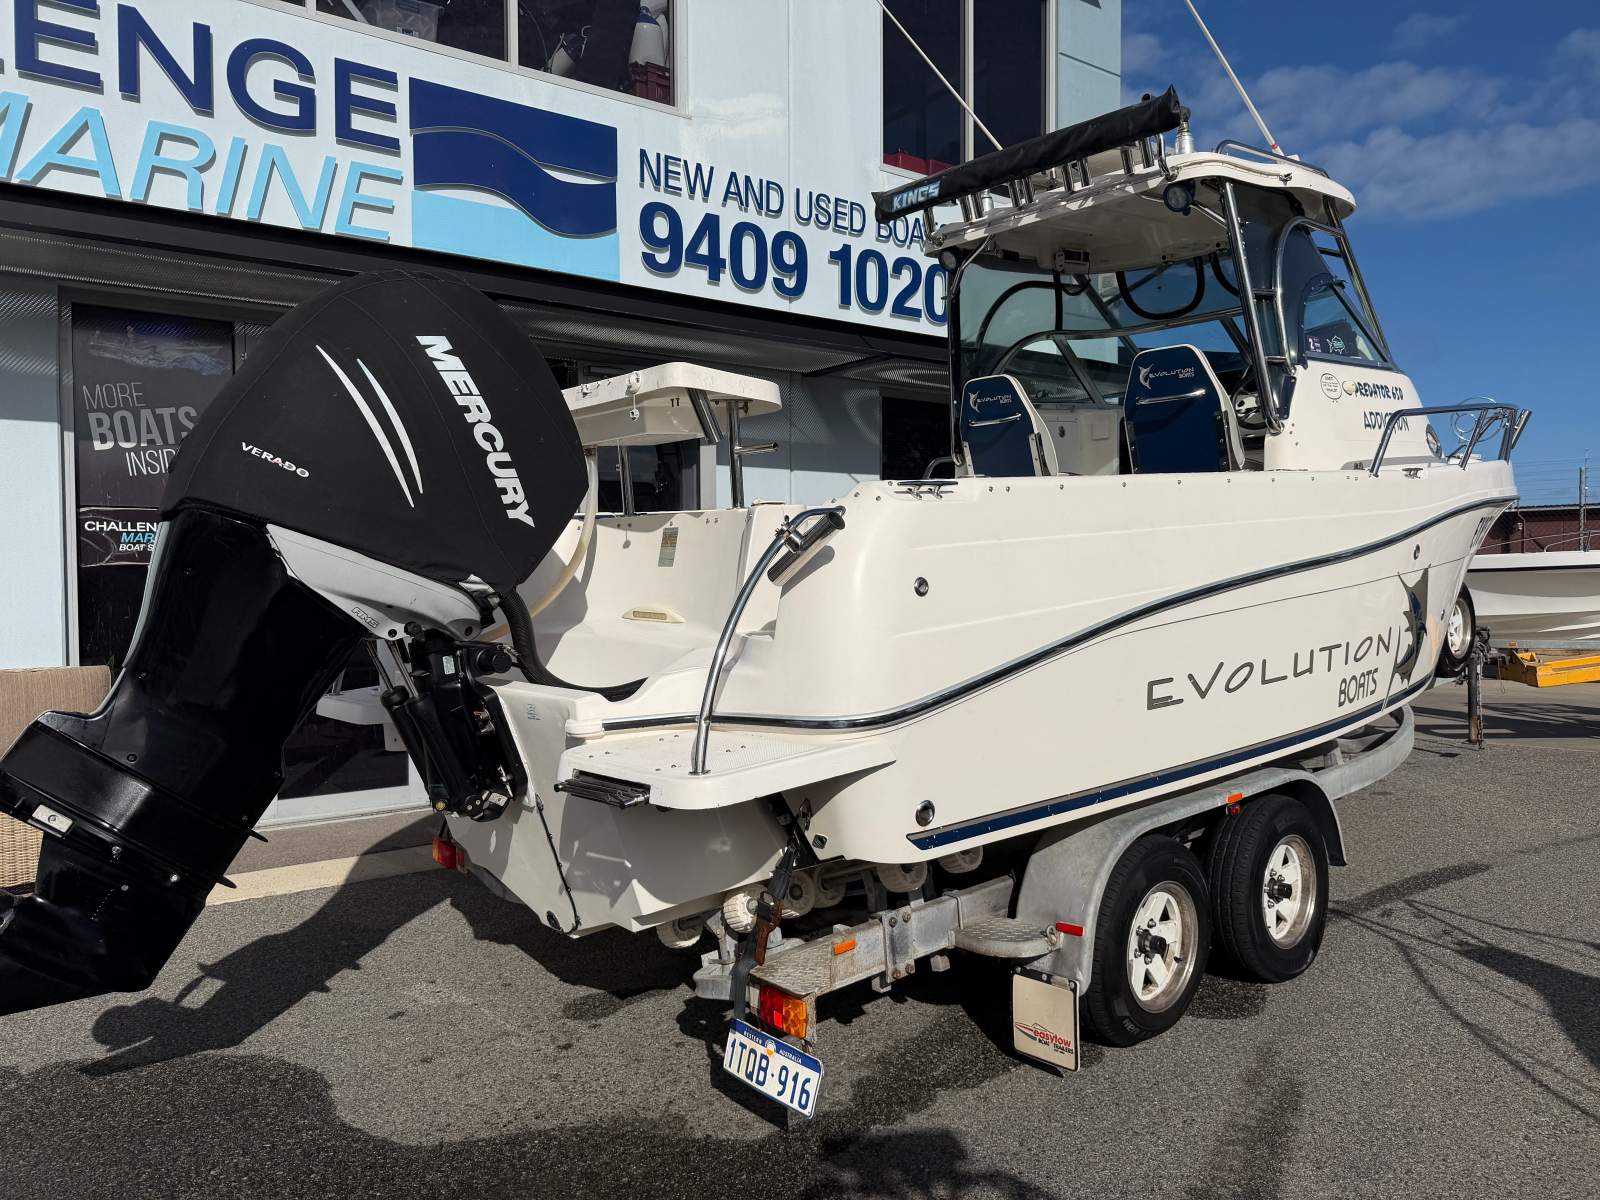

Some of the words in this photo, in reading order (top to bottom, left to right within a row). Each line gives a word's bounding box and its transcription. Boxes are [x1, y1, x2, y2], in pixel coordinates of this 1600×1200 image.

[0, 0, 401, 157] ENGE
[639, 148, 714, 202] NEW
[721, 171, 785, 217] AND
[794, 187, 866, 236] USED
[876, 214, 946, 250] BOA
[893, 181, 941, 211] KINGS
[639, 201, 808, 300] 9409
[828, 243, 948, 326] 1020
[82, 382, 146, 410] MORE
[87, 406, 198, 451] BOATS
[415, 335, 535, 528] MERCURY
[126, 448, 175, 476] INSID
[241, 441, 310, 478] VERADO
[84, 521, 157, 532] CHALLEN
[121, 532, 154, 543] MAR
[119, 543, 146, 551] BOAT
[1146, 627, 1393, 710] EVOLUTION
[1338, 668, 1378, 708] BOATS
